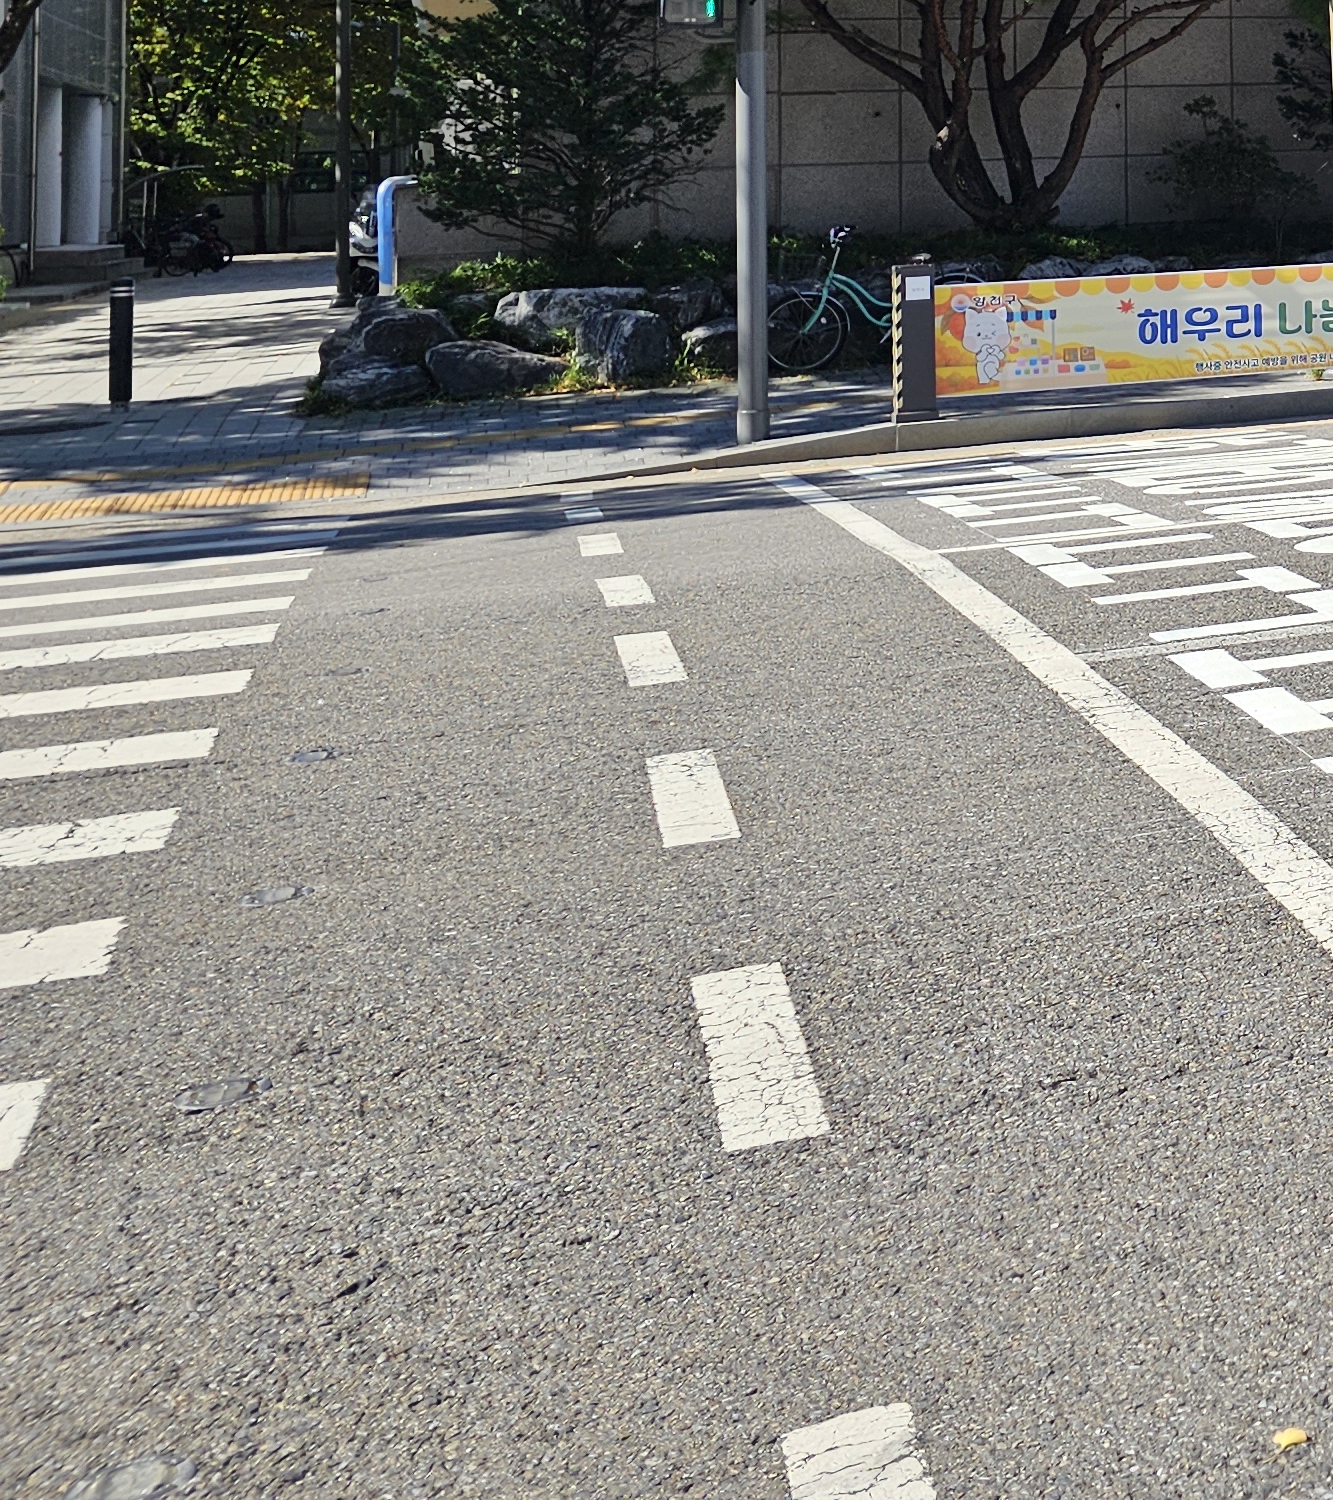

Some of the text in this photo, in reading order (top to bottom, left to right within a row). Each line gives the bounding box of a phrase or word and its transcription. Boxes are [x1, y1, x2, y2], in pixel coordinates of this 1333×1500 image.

[972, 295, 1016, 307] 양천구
[1136, 303, 1263, 345] 해우리
[1224, 358, 1259, 370] 안전사고
[1261, 356, 1288, 367] 예방을
[1290, 354, 1308, 365] 위해
[1309, 353, 1327, 363] 공원
